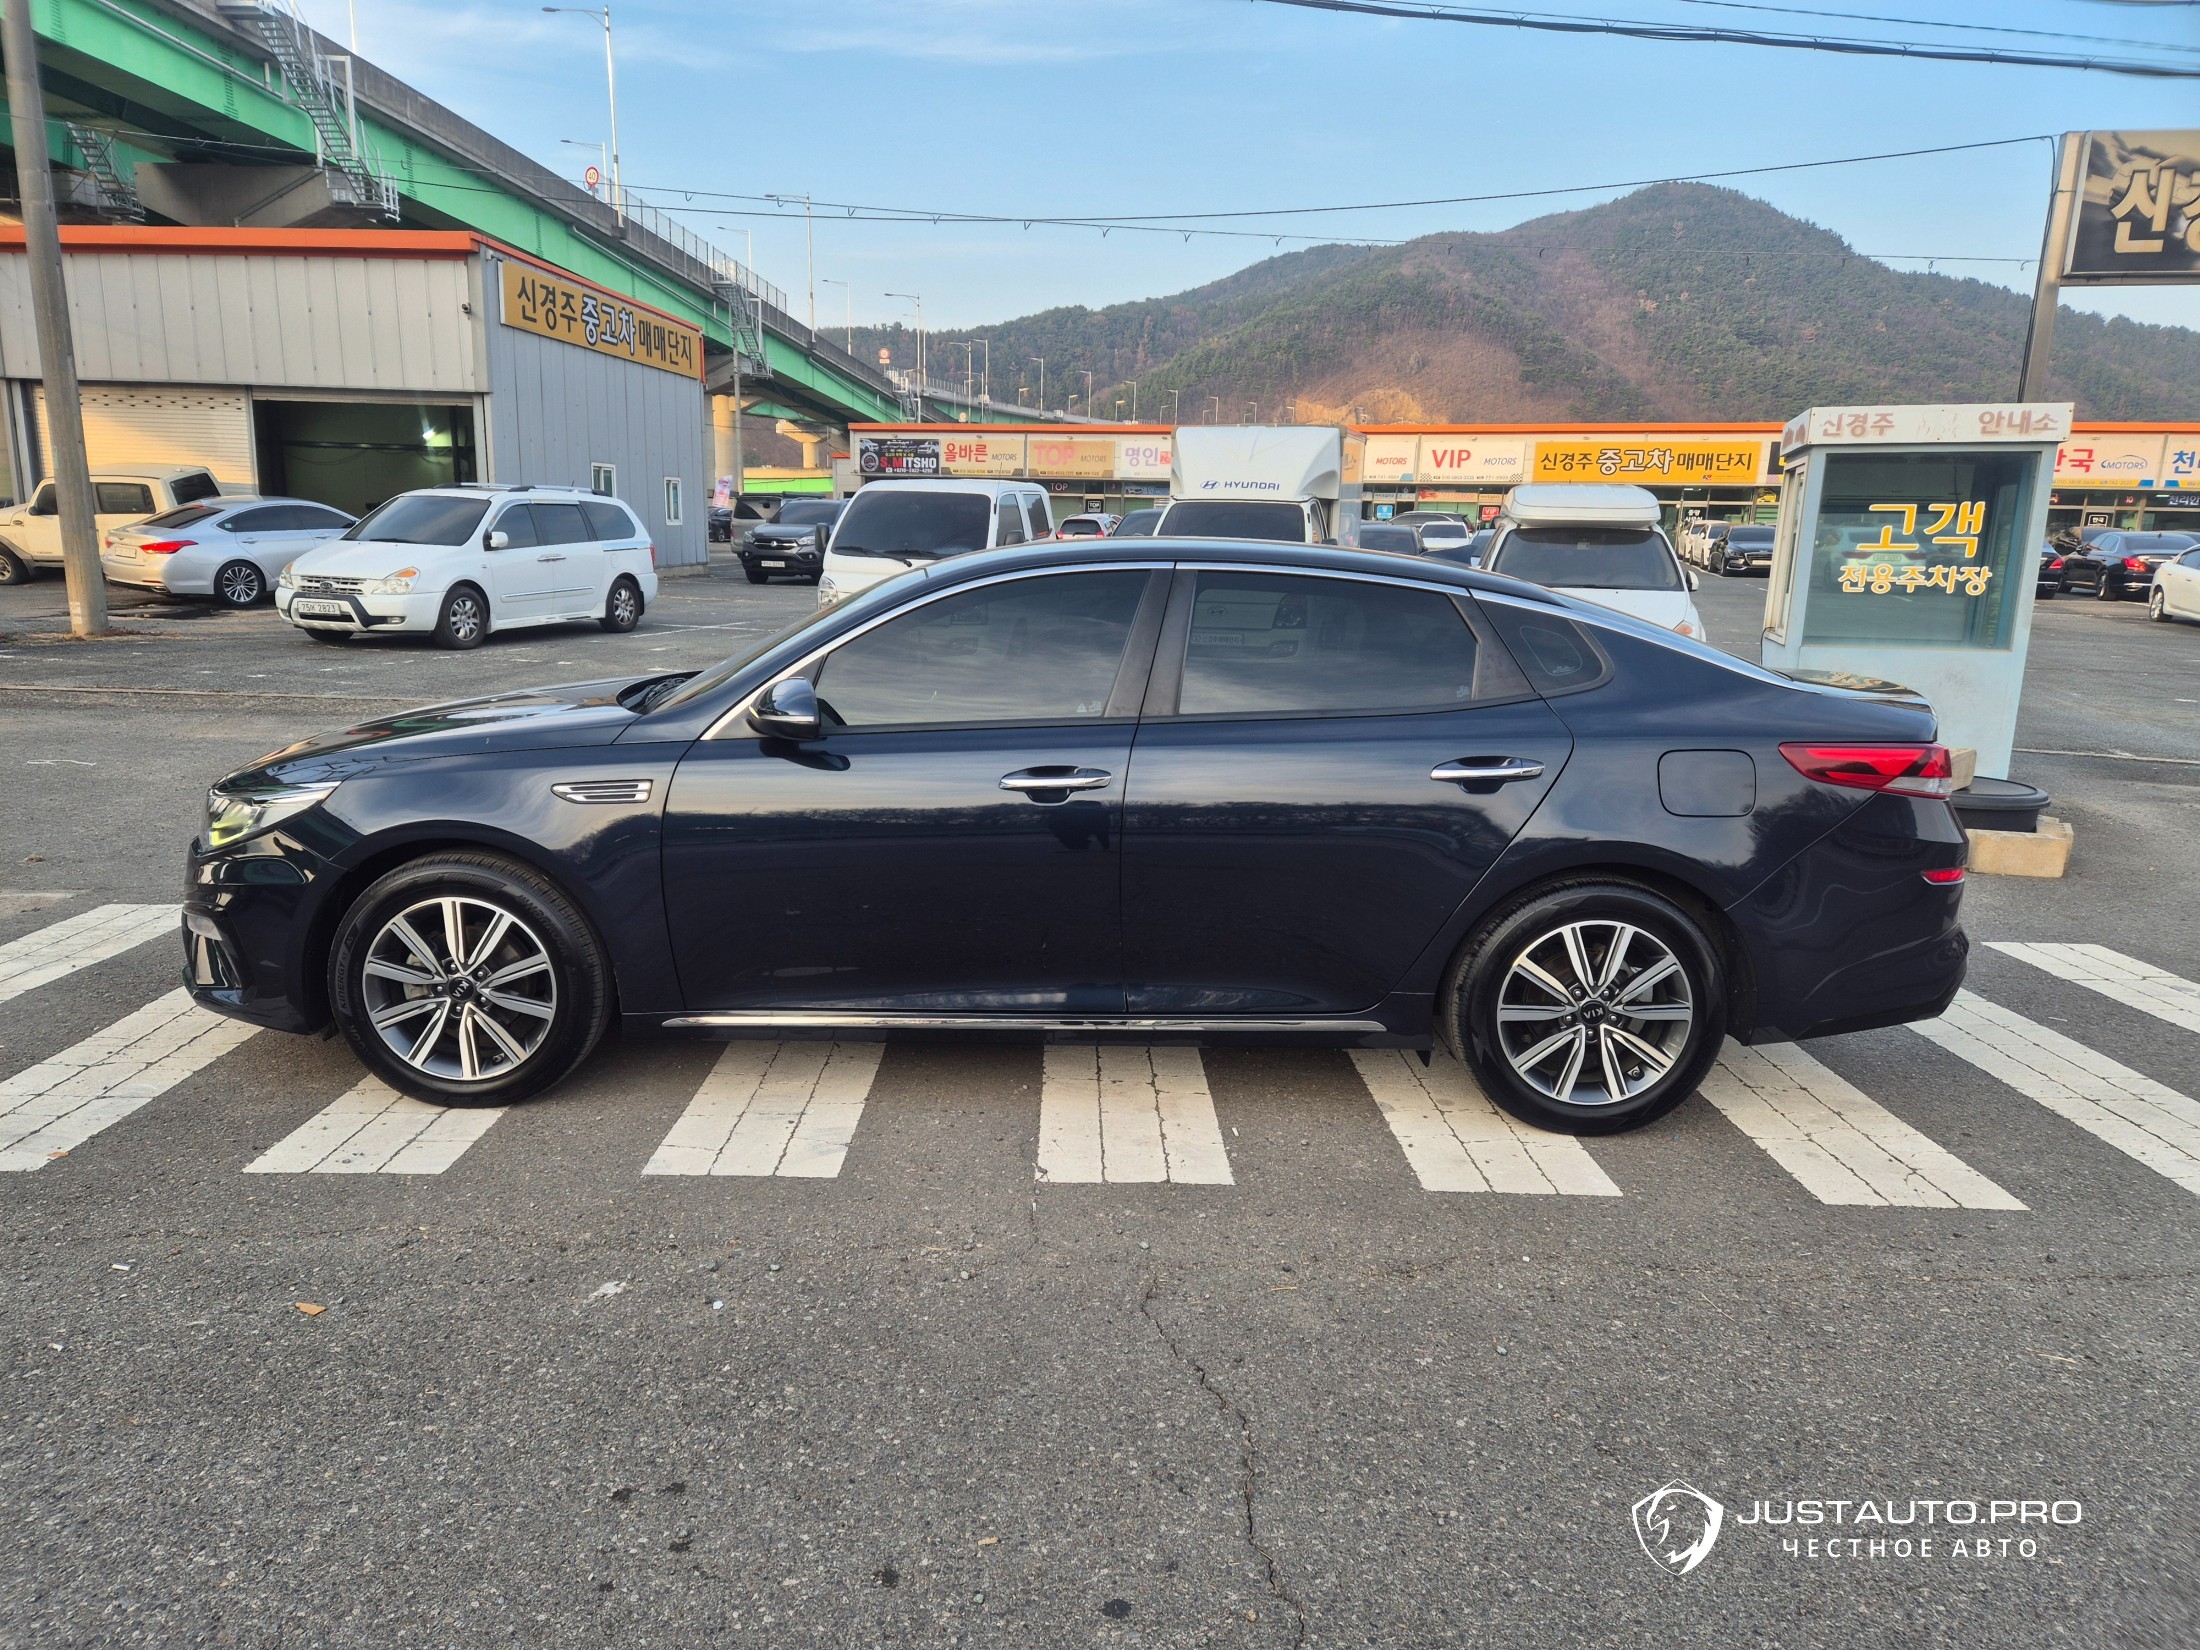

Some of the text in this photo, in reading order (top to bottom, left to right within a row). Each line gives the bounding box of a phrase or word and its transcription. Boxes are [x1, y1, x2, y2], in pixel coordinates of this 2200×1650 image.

[588, 171, 596, 181] 40
[517, 276, 692, 369] 신경주 중고차 매매단지
[1821, 412, 1896, 438] 신경주
[1978, 410, 2059, 435] 안내소
[943, 443, 988, 463] 올바른
[991, 453, 1017, 461] MOTORS
[1033, 444, 1107, 466] TOP MOTORS
[1124, 447, 1159, 467] 명인
[1375, 457, 1408, 465] MOTORS
[1431, 449, 1518, 469] VIP MOTORS
[1540, 448, 1753, 475] 신경주 중고차 매매단지
[2172, 450, 2200, 474] 천
[2106, 462, 2145, 470] MOTORS
[1050, 482, 1069, 491] TOP
[1224, 481, 1280, 491] HYUNDAI
[1856, 501, 1986, 558] 고객
[1838, 563, 1993, 596] 전용주차장
[317, 603, 336, 613] 2823
[336, 958, 349, 1010] KINERGY
[452, 979, 471, 998] KIA
[1583, 1007, 1604, 1019] KIA
